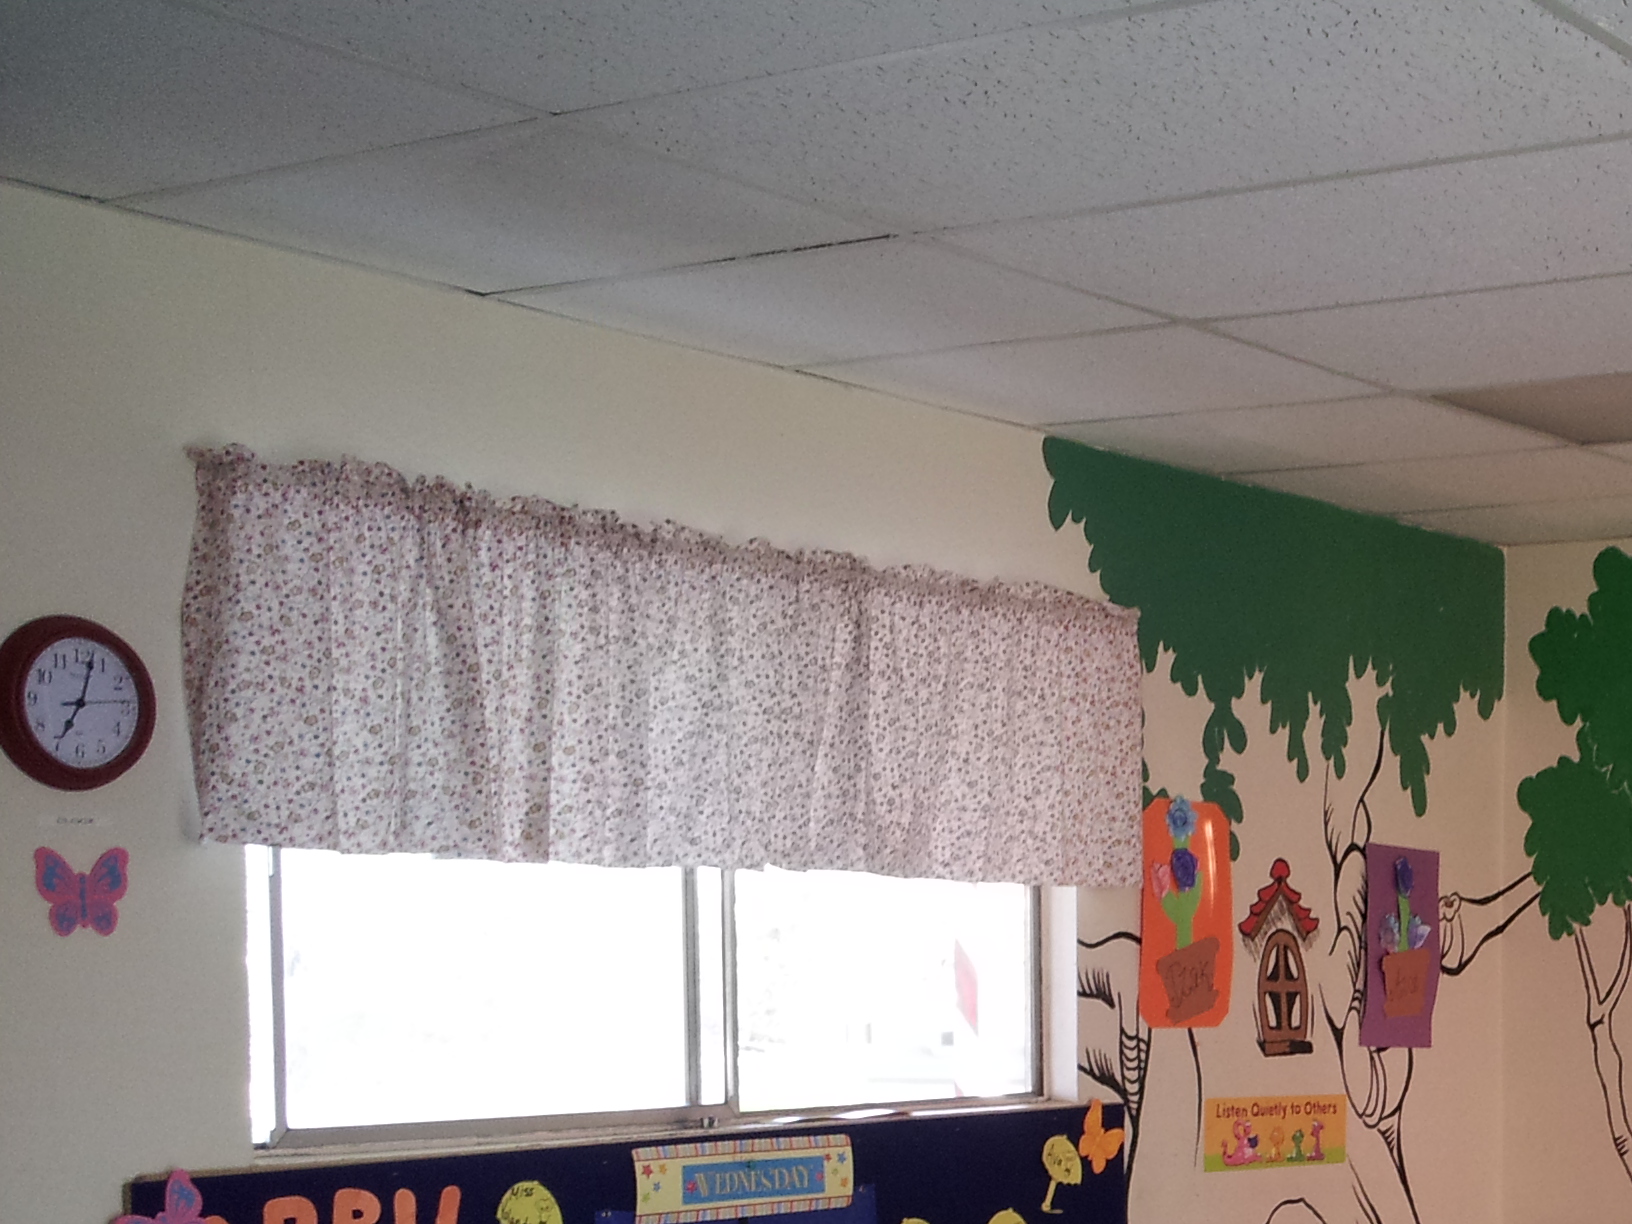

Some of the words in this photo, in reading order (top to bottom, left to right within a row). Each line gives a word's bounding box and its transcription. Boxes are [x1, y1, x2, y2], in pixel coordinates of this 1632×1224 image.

[54, 653, 66, 669] 11
[101, 658, 105, 673] 1
[1216, 1103, 1248, 1118] Listen
[1251, 1102, 1287, 1120] Quietly
[1291, 1103, 1301, 1115] to
[1304, 1101, 1338, 1115] Others
[695, 1164, 812, 1198] WEDNESDAY
